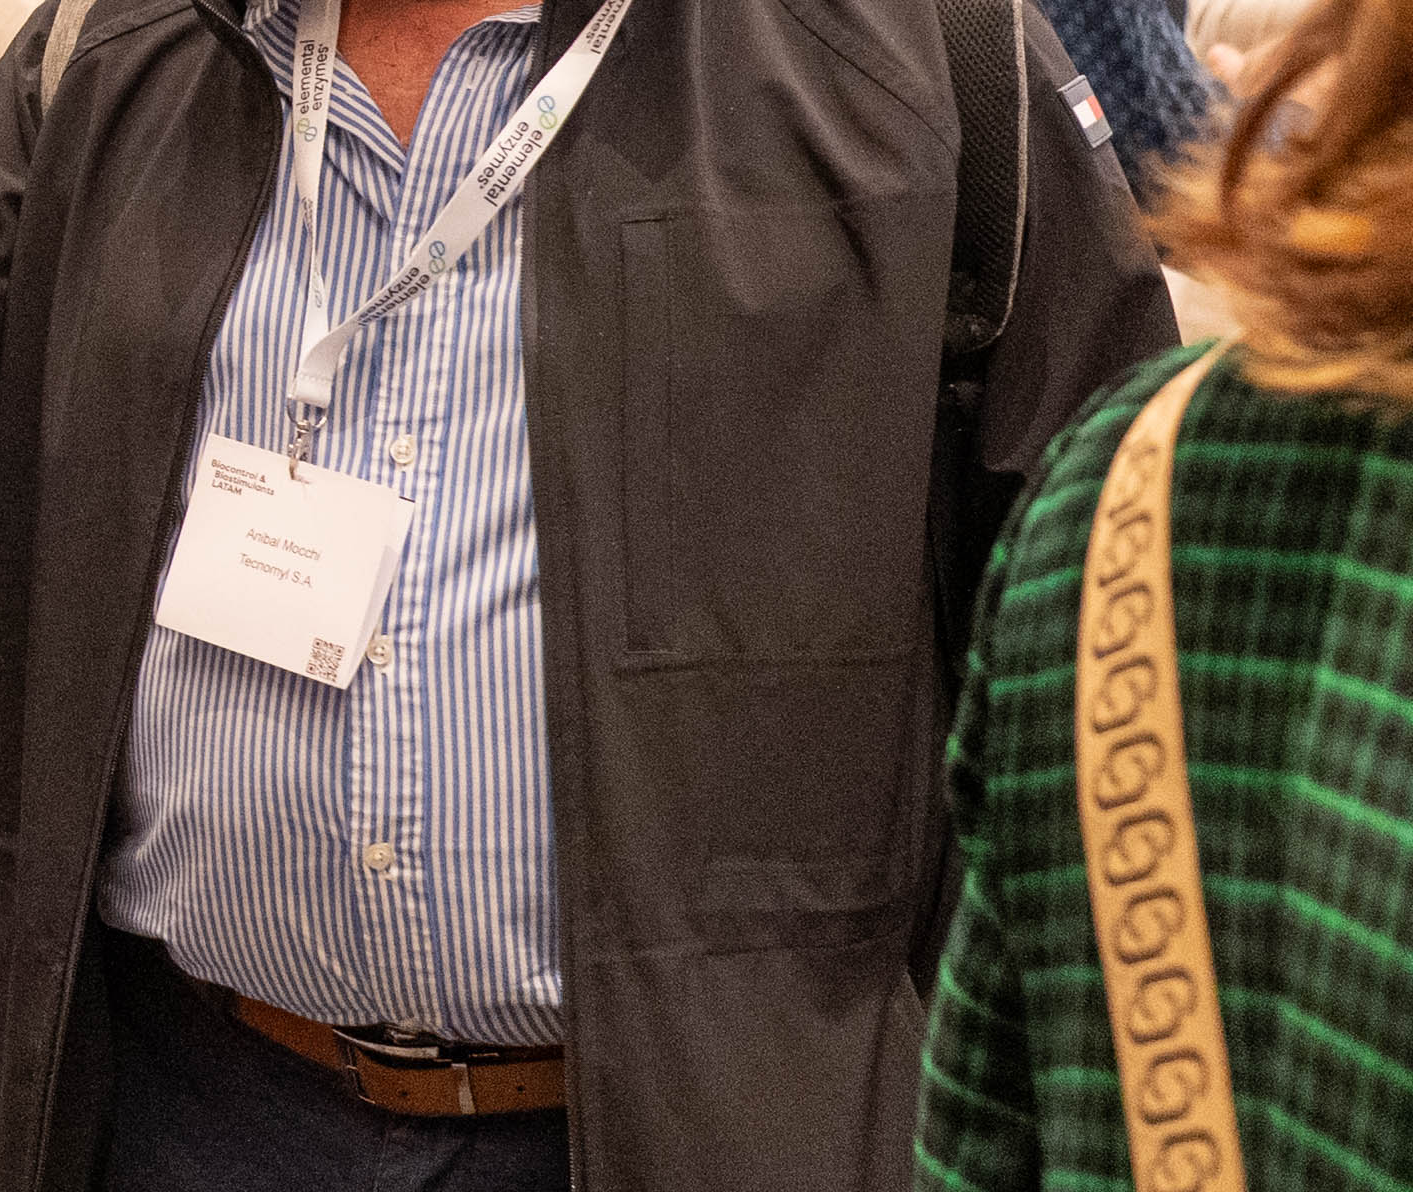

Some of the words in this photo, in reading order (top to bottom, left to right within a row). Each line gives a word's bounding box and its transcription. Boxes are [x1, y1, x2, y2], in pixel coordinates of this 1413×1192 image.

[290, 38, 315, 114] elemental
[483, 129, 543, 207] elemental
[211, 459, 258, 481] Biocontrol
[259, 474, 266, 483] &
[214, 470, 275, 496] Biostimulants
[211, 479, 242, 496] LATAM
